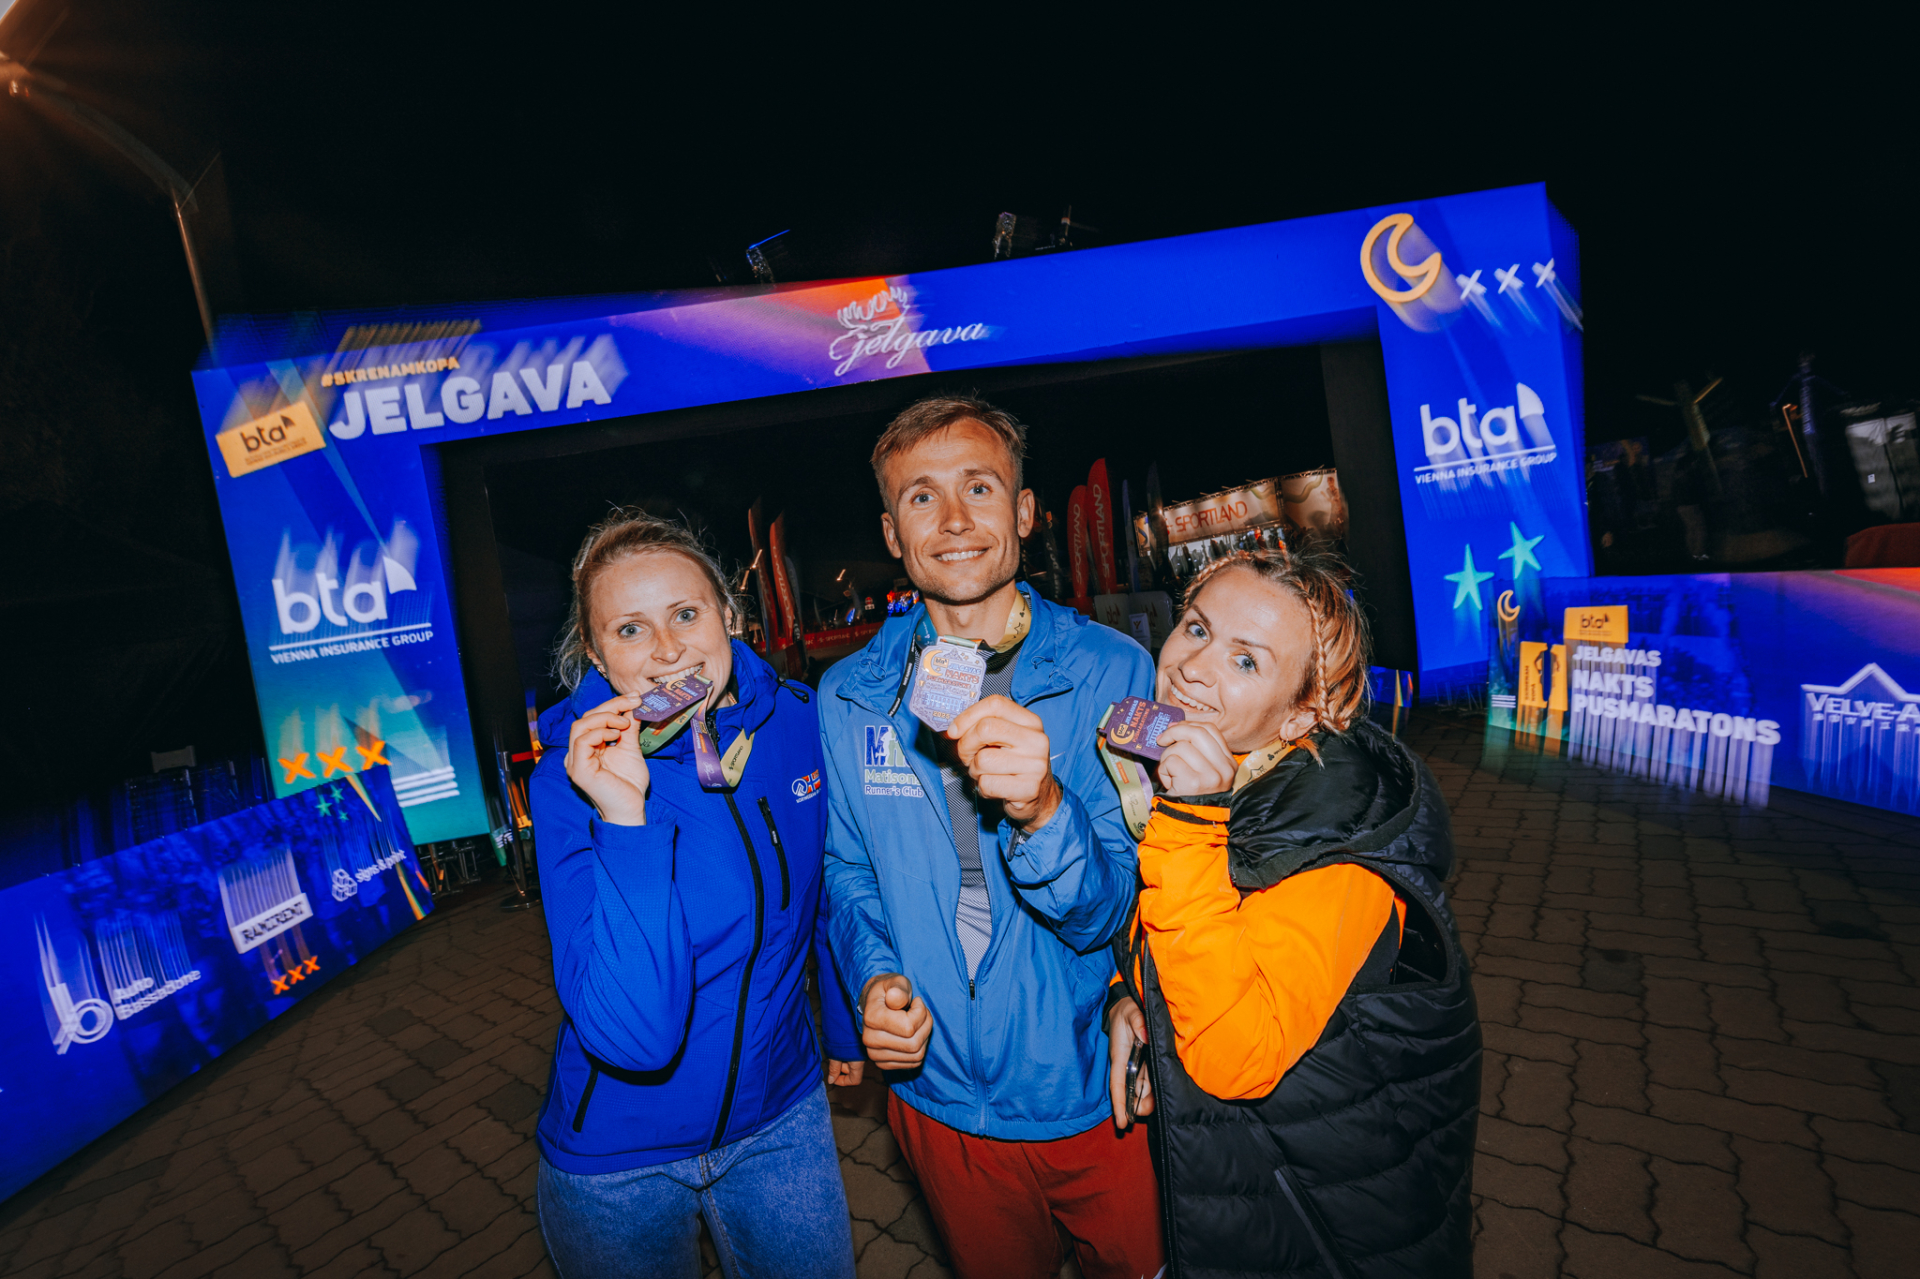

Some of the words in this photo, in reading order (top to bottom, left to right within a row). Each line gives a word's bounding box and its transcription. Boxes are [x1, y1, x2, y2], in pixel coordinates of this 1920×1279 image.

[329, 360, 612, 440] JELGAVA
[239, 424, 287, 454] bta
[1420, 397, 1518, 457] bta
[1415, 470, 1456, 484] VIENNA
[1457, 459, 1518, 477] INSURANCE
[1519, 452, 1557, 468] GROUP
[1175, 500, 1248, 533] SPORTLAND
[1073, 503, 1082, 585] SPORTLAND
[272, 572, 388, 635] bta
[1581, 613, 1605, 629] bta
[271, 646, 319, 664] VIENNA
[319, 637, 390, 657] INSURANCE
[391, 630, 434, 647] GROUP
[1572, 645, 1662, 668] JELGAVAS
[945, 669, 980, 684] NAKTS
[1571, 669, 1655, 698] NAKTS
[1130, 701, 1147, 728] NAKTS
[1572, 693, 1781, 746] PUSMARATONS
[865, 784, 901, 797] Runner's
[902, 785, 925, 799] Club
